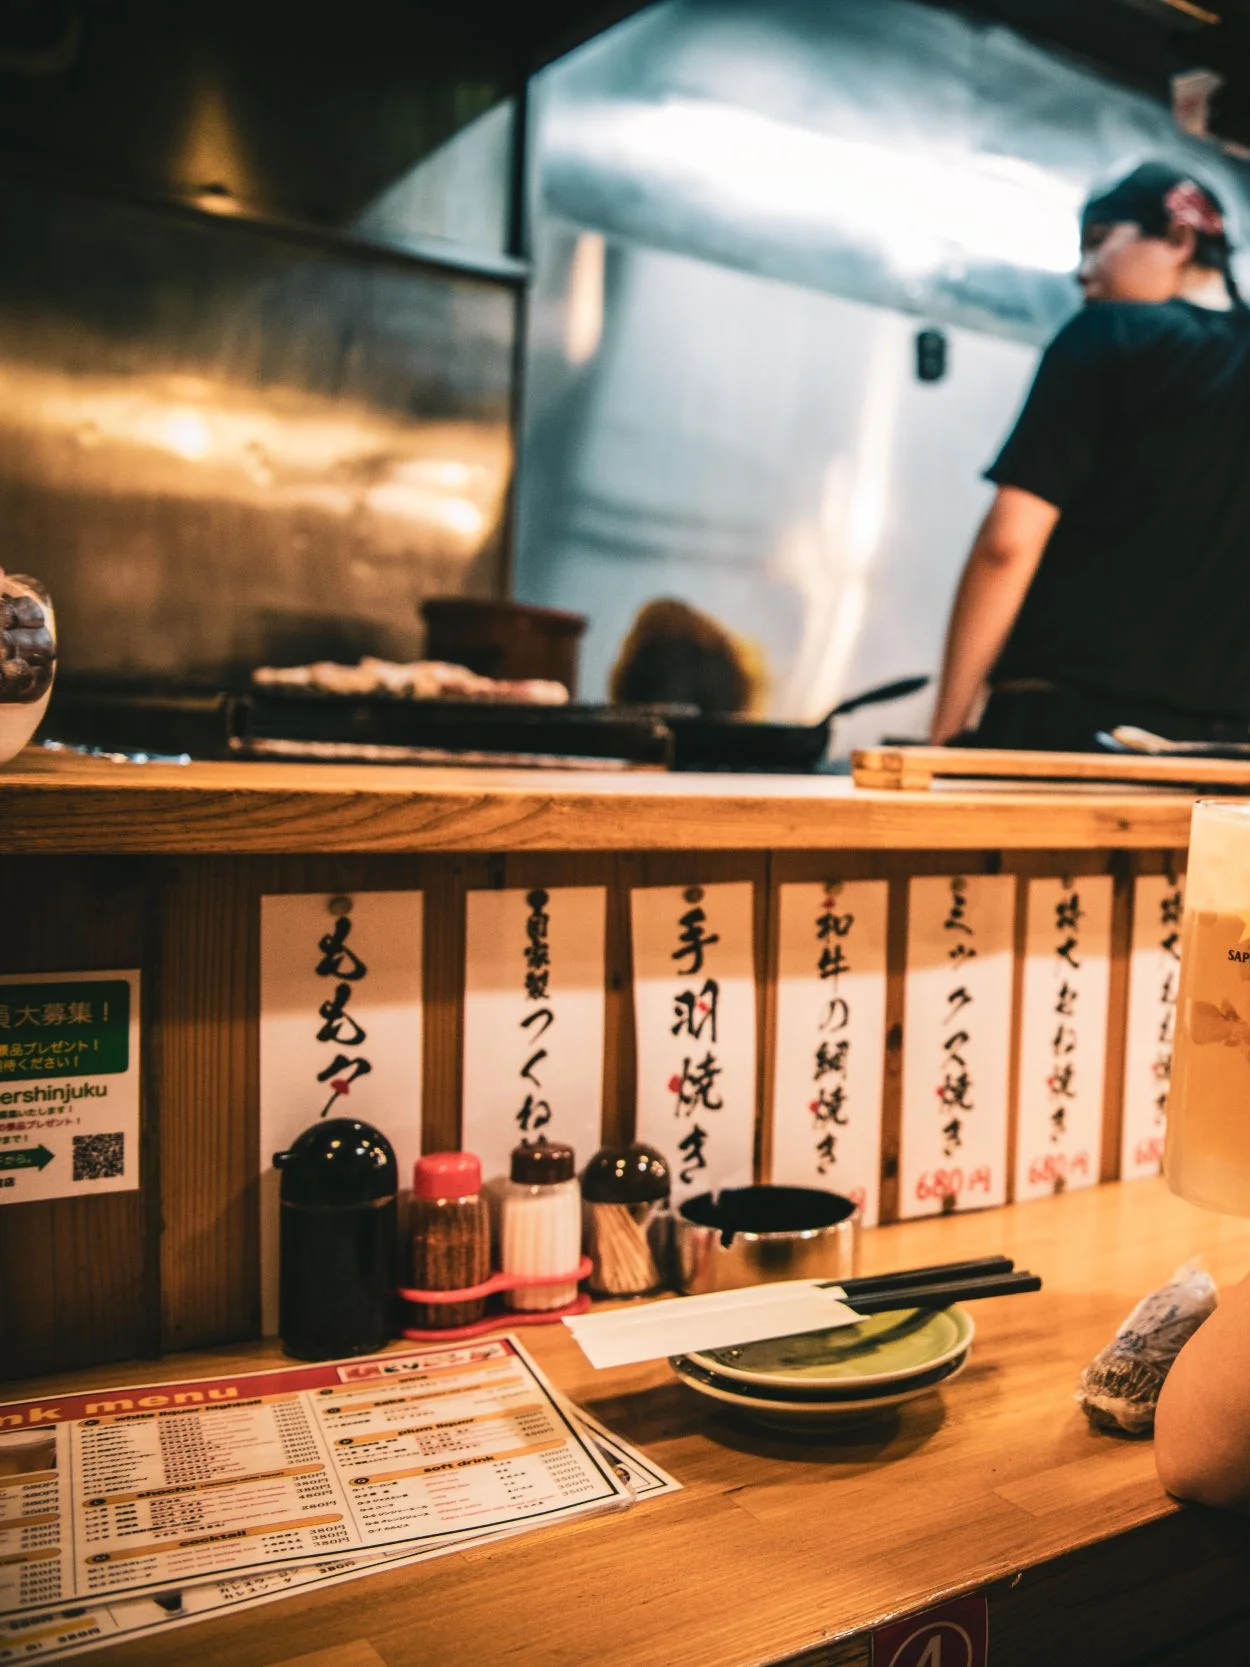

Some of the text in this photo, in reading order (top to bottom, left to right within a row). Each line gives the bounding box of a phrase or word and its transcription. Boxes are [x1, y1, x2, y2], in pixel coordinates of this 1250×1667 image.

[85, 1386, 239, 1415] menu
[423, 1456, 495, 1473] soft drink
[178, 1530, 248, 1547] cocktail
